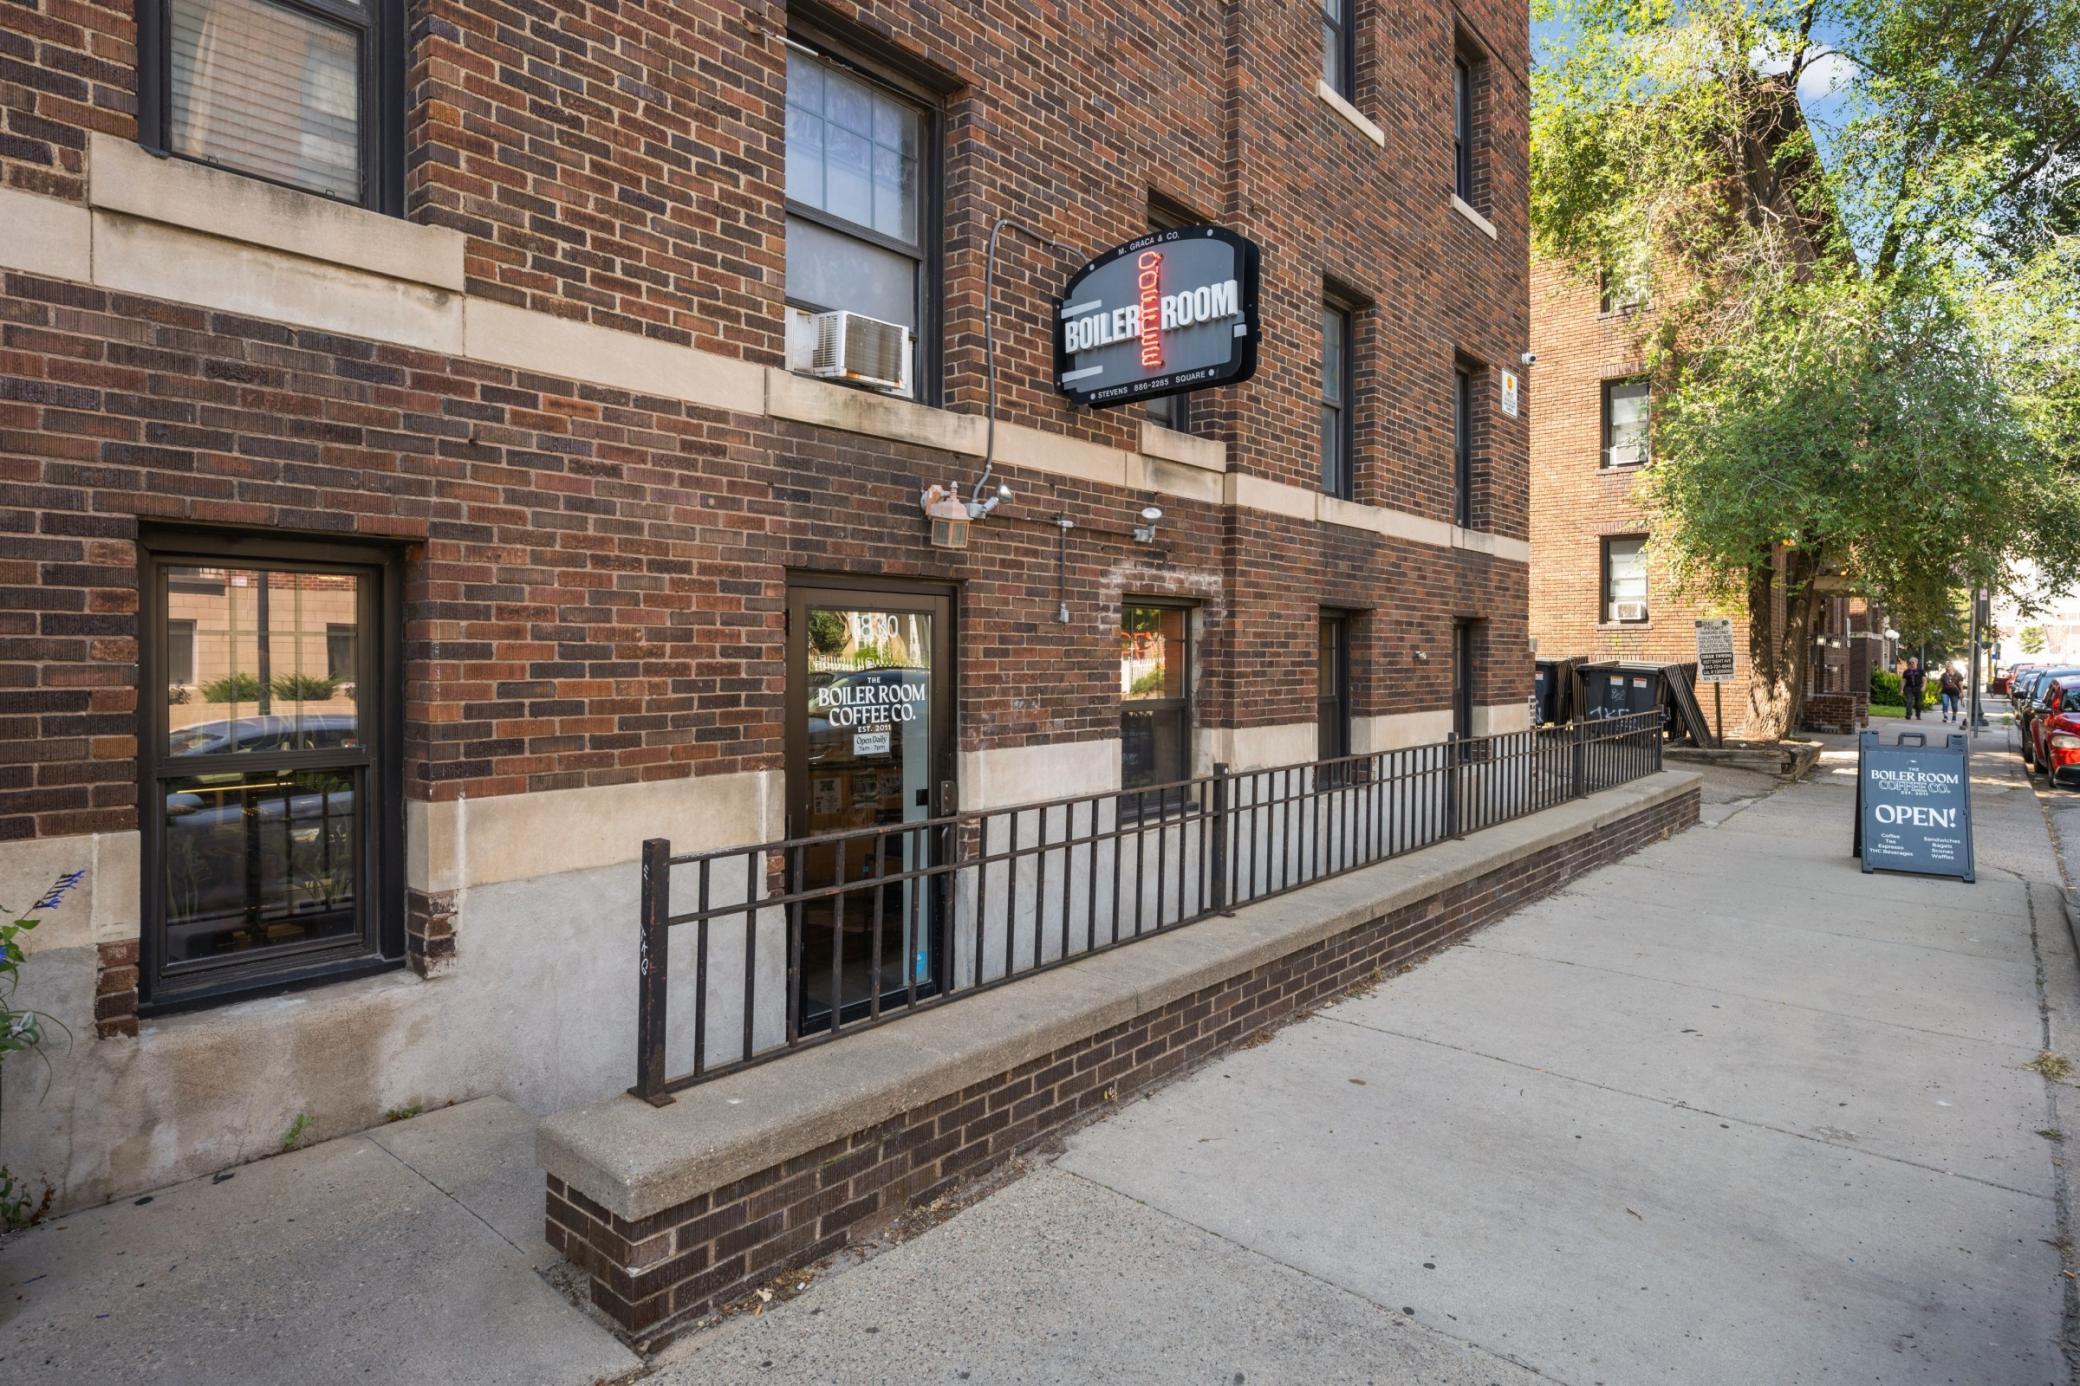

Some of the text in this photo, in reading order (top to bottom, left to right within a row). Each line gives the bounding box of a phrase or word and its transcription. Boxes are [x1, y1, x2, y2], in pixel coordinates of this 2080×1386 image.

[1118, 231, 1180, 256] M. GRACA & CO.
[1065, 279, 1239, 354] BOILER ROOM
[1097, 385, 1128, 399] STEVENS
[1175, 370, 1205, 384] SQUARE
[867, 676, 881, 684] THE
[818, 684, 925, 707] BOILER ROOM
[829, 703, 916, 727] COFFEE CO.
[858, 724, 892, 733] EST. 2011
[856, 734, 887, 745] Open Daily
[1871, 769, 1959, 785] BOILER ROOM
[1878, 780, 1951, 794] COFFEE CO.
[1875, 804, 1956, 828] OPEN!
[1923, 836, 1961, 844] Sandwiches
[1882, 848, 1914, 857] Beverages
